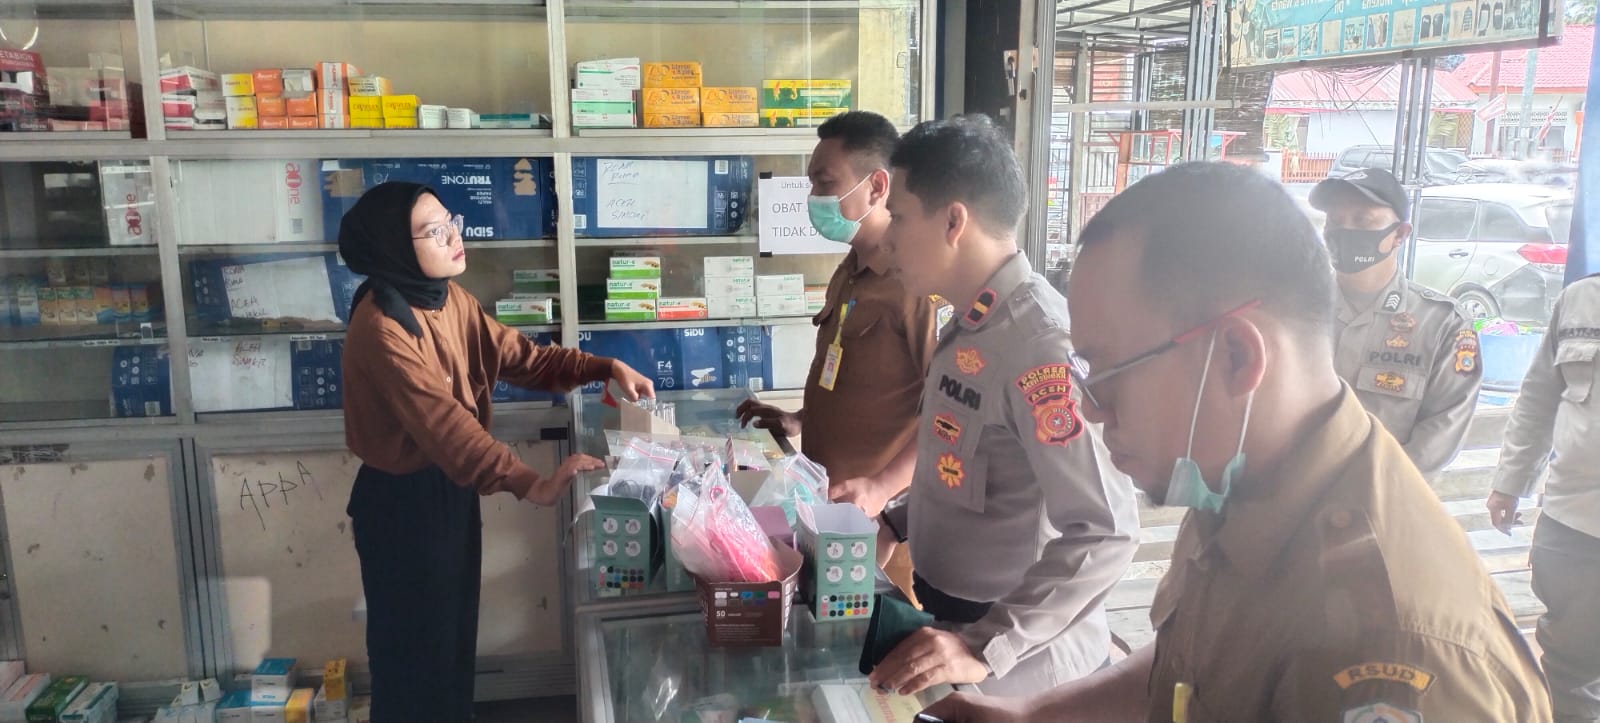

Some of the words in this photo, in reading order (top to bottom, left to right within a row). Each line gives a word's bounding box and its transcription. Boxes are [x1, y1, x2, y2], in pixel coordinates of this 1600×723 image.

[441, 175, 492, 185] TRUTONE
[771, 202, 803, 214] OBAT
[771, 226, 807, 238] TIDAK
[497, 303, 522, 311] natur-e
[1369, 351, 1421, 366] POLRI
[657, 360, 673, 371] F4
[1021, 366, 1066, 385] POLRES
[658, 376, 675, 388] 70
[938, 374, 982, 411] POLRI
[1031, 385, 1066, 402] ACEH
[716, 610, 726, 618] 50
[1348, 664, 1416, 682] RSUD
